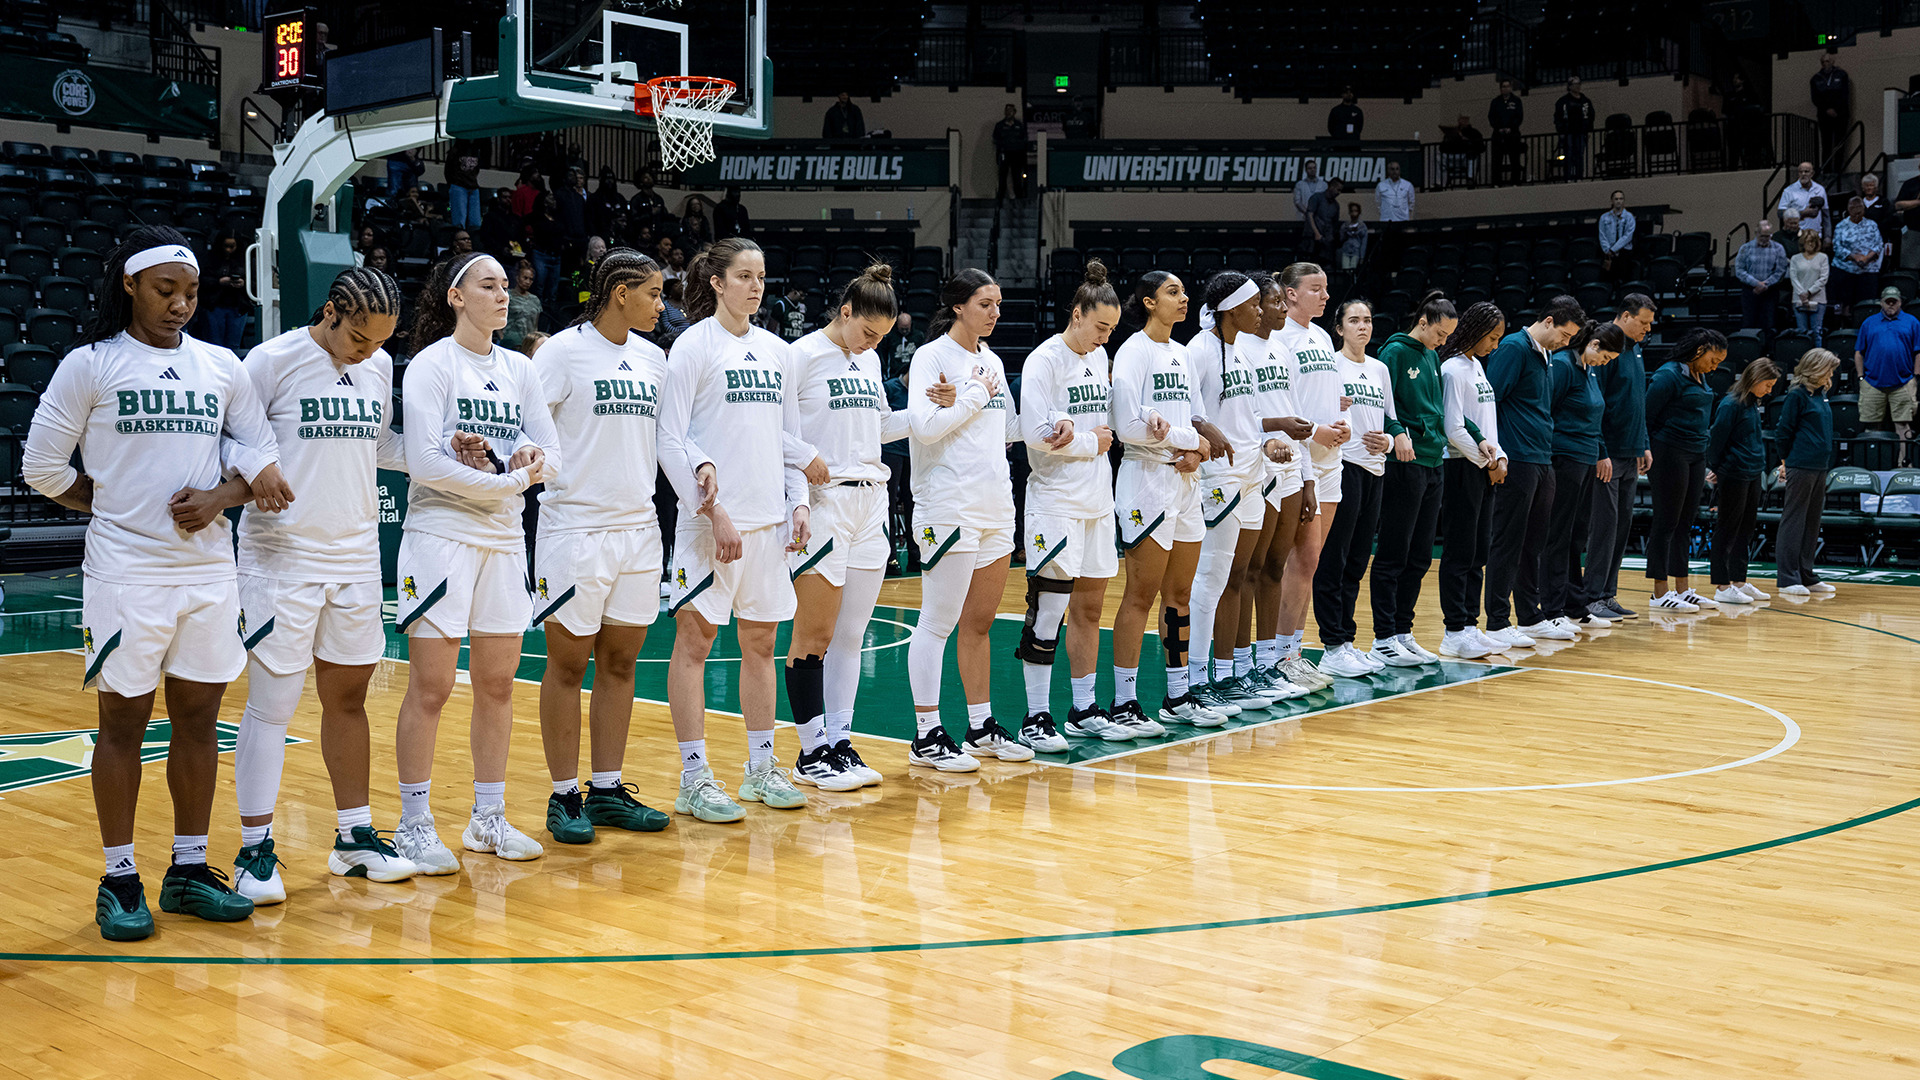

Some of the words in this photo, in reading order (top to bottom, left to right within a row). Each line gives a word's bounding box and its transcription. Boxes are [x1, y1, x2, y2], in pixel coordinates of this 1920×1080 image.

[279, 47, 299, 76] 30
[62, 82, 88, 98] CORE
[271, 78, 300, 87] DAKTRONICS
[62, 95, 88, 108] POWER
[719, 155, 775, 181] HOME
[776, 155, 801, 181] OF
[805, 155, 841, 181] THE
[841, 155, 904, 181] BULLS
[1082, 155, 1202, 182] UNIVERSITY
[1203, 156, 1230, 182] OF
[1232, 156, 1300, 182] SOUTH
[725, 369, 782, 391] BULLS
[593, 379, 658, 406] BULLS
[1343, 383, 1385, 400] BULLS
[116, 389, 219, 419] BULLS
[299, 397, 382, 424] BULLS
[600, 403, 656, 417] BASKETBAL
[1352, 397, 1385, 408] ASKETBALL
[456, 398, 522, 427] BULLS
[122, 420, 217, 435] BASKETBALL
[378, 509, 402, 523] ital.
